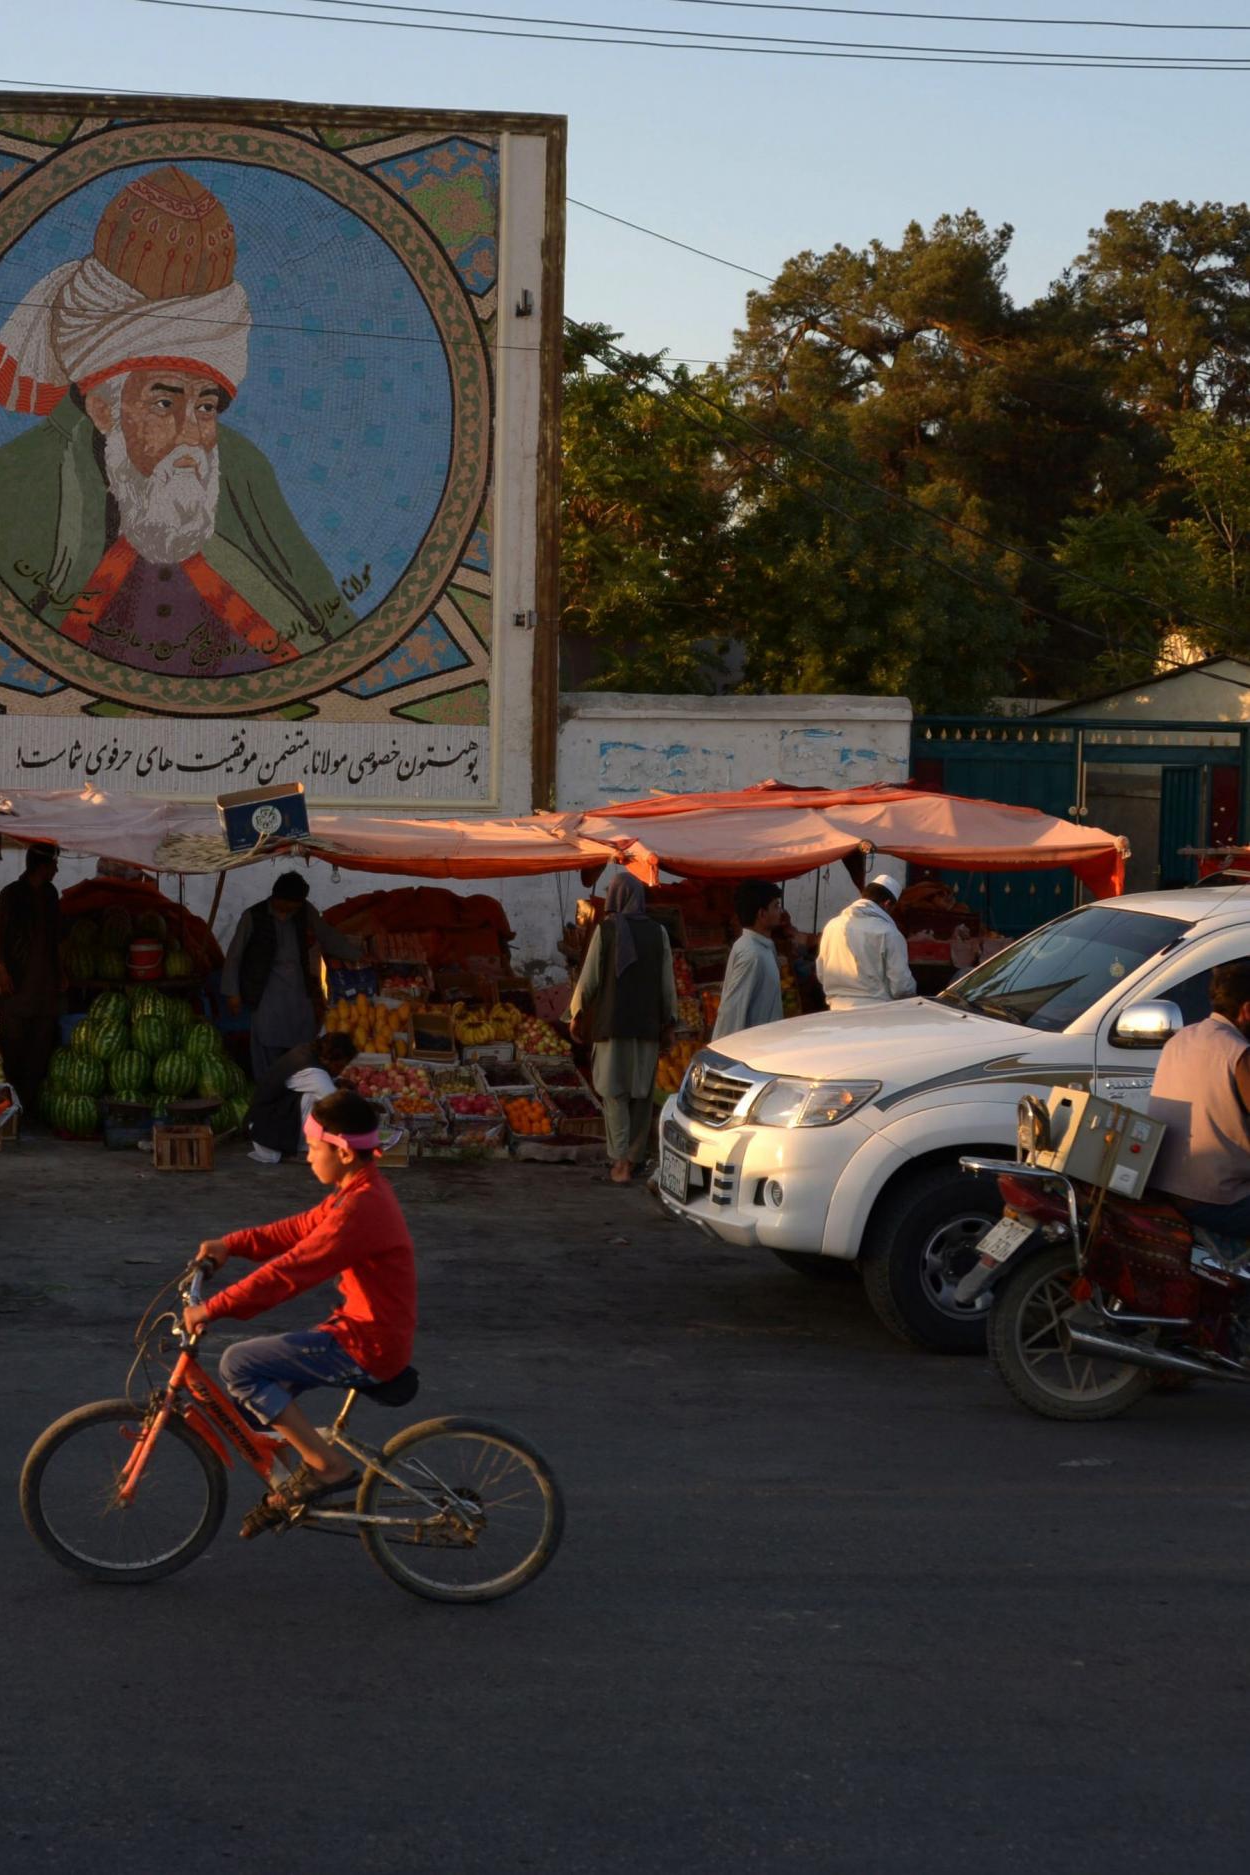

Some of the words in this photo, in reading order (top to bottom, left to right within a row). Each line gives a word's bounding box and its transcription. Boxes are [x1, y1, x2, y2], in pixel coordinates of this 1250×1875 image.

[341, 564, 371, 601] مولانا
[87, 616, 143, 648] عارف
[308, 595, 349, 636] جلال
[85, 738, 133, 775] حرفوی
[136, 745, 174, 777] های
[176, 727, 258, 774] موفقیت
[257, 730, 310, 785] متضمن
[347, 739, 400, 785] خصوصی
[397, 740, 480, 785] پوهنتون
